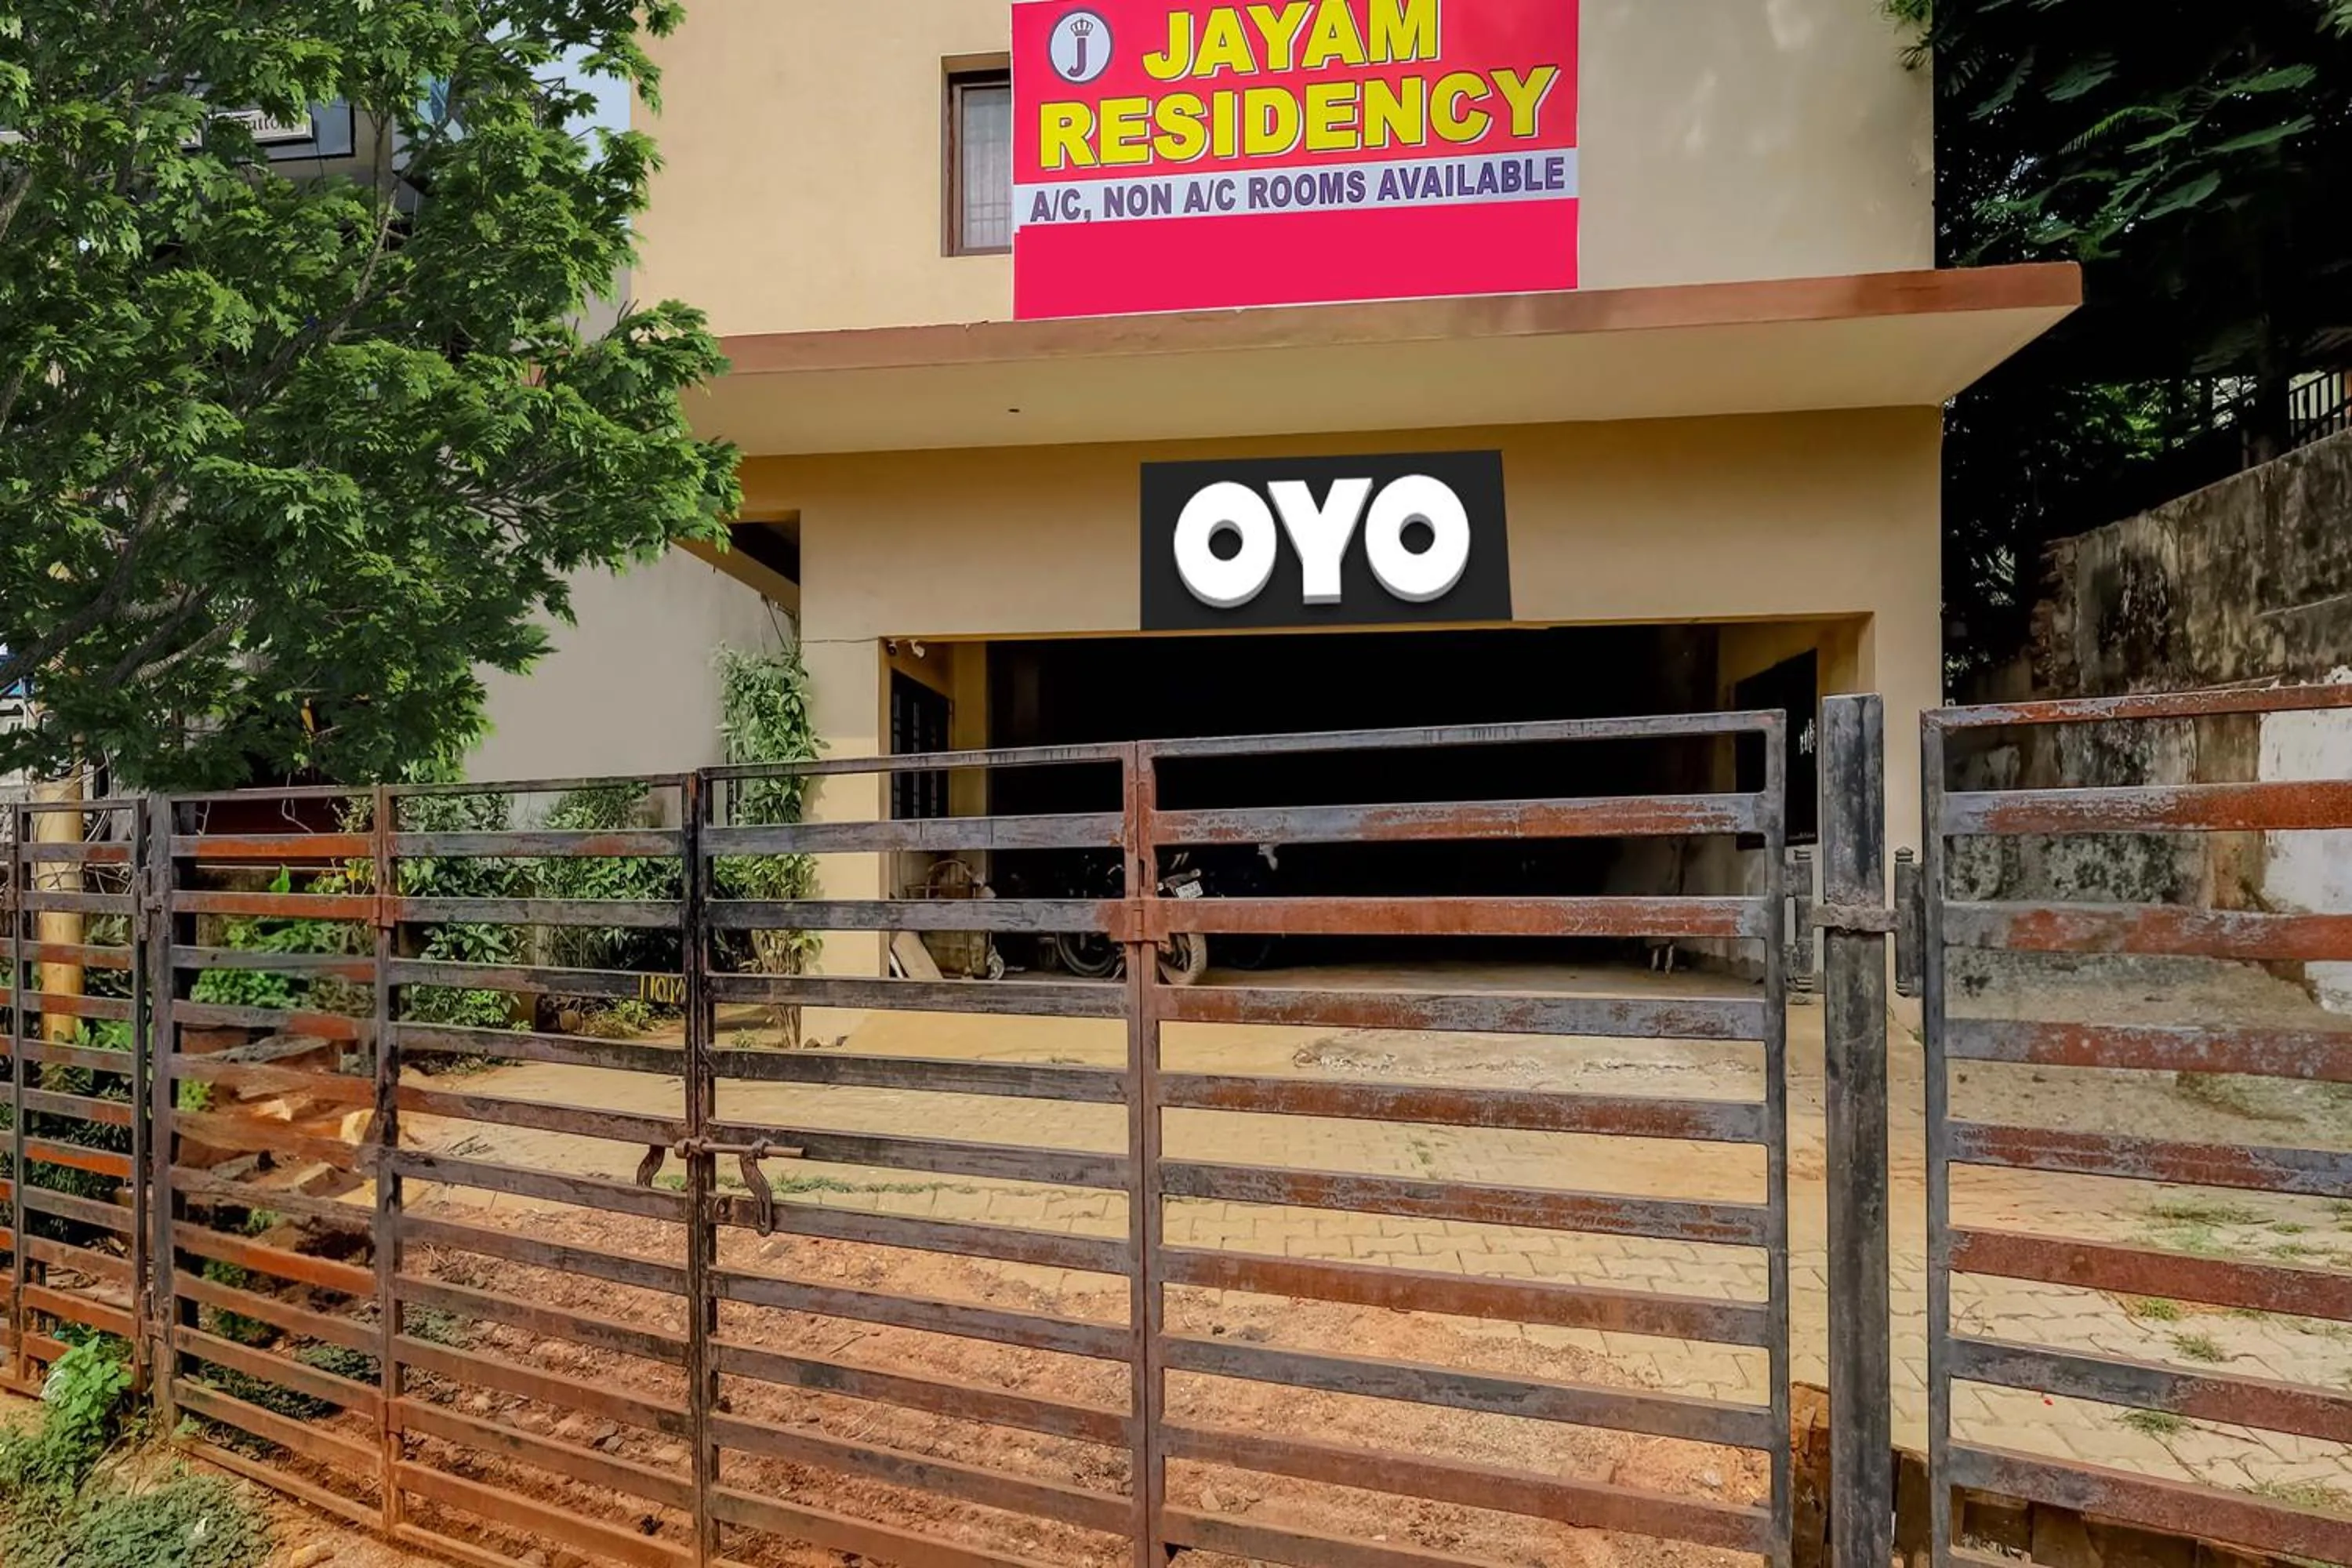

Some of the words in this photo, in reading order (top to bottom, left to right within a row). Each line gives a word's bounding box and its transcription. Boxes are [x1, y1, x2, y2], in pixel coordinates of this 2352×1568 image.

[1067, 37, 1087, 77] J
[1142, 0, 1440, 80] JAYAM
[1039, 64, 1559, 169] RESIDENCY
[1029, 188, 1091, 223] A/C,
[1103, 183, 1172, 219] NON
[1183, 178, 1236, 213] A/C
[1248, 170, 1367, 209] ROOMS
[1377, 157, 1565, 201] AVAILABLE
[1174, 474, 1471, 609] OYO
